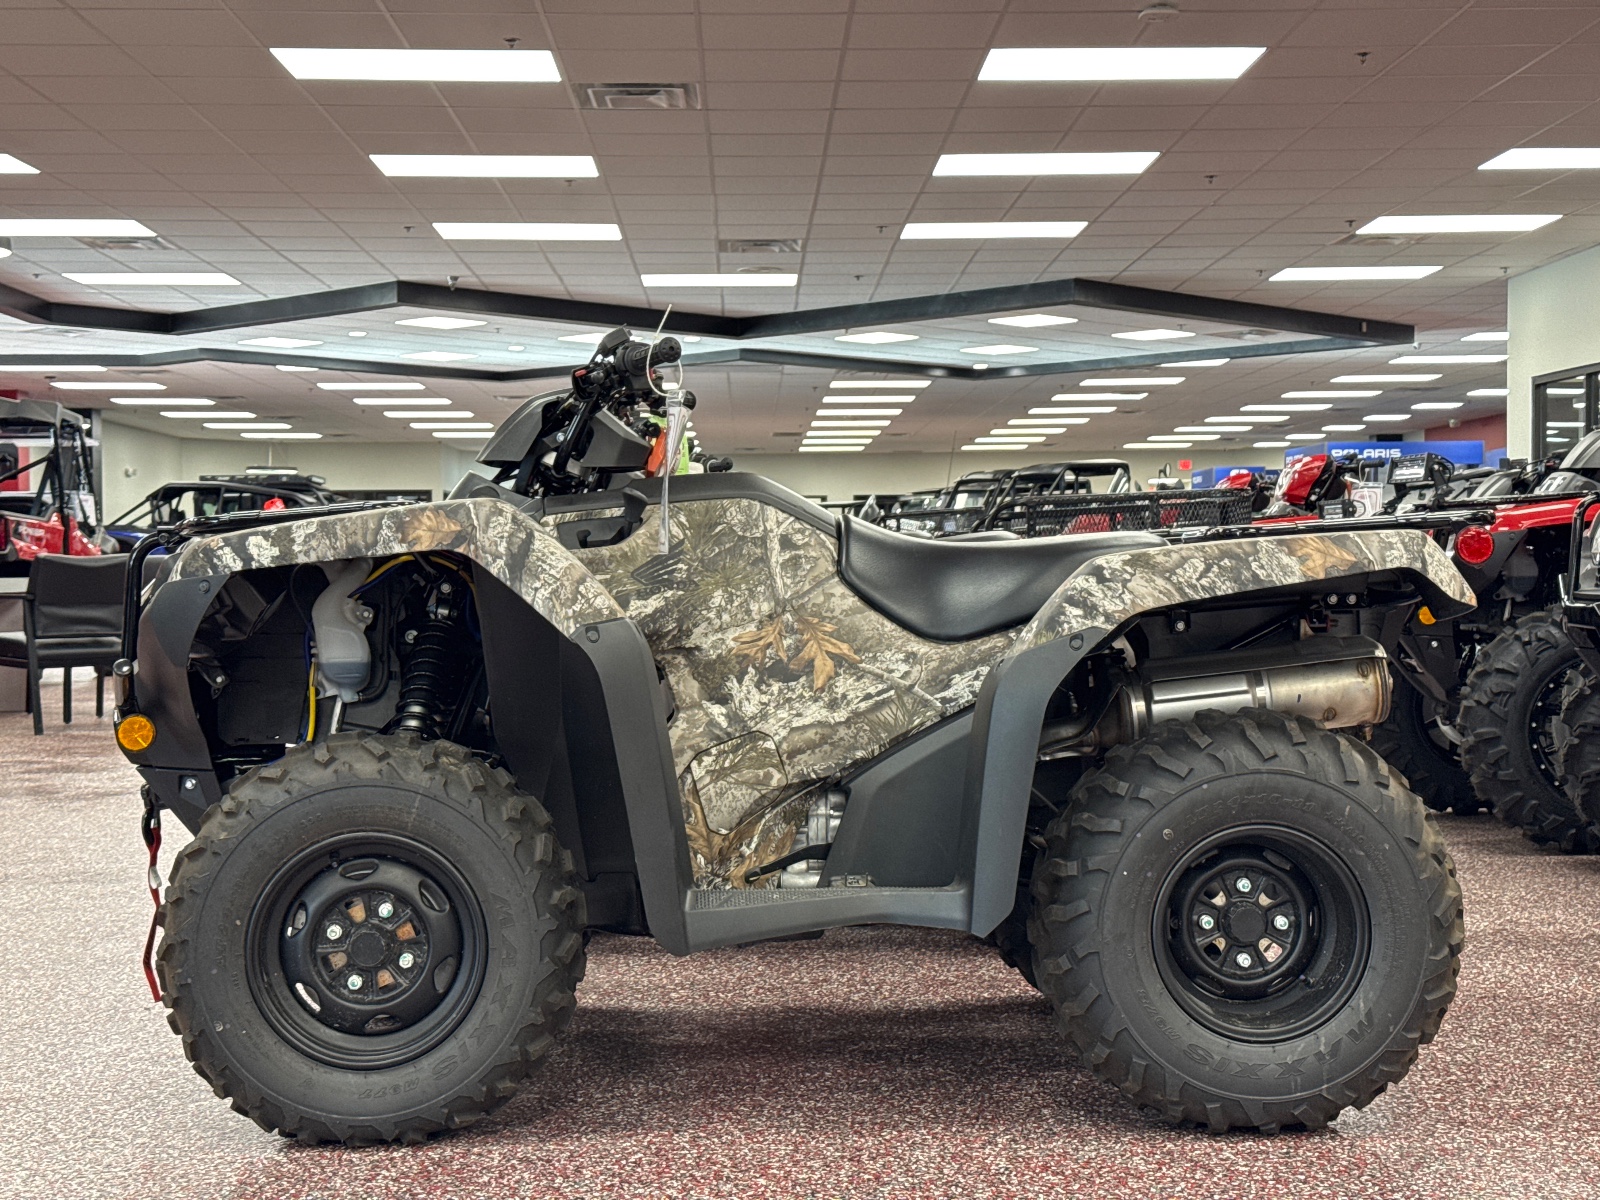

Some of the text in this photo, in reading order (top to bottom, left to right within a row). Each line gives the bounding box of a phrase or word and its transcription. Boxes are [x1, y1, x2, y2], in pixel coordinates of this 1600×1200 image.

[1331, 448, 1402, 458] POLARIS
[358, 892, 517, 1099] MAXXIS M977
[1182, 1006, 1375, 1079] MAXXIS
